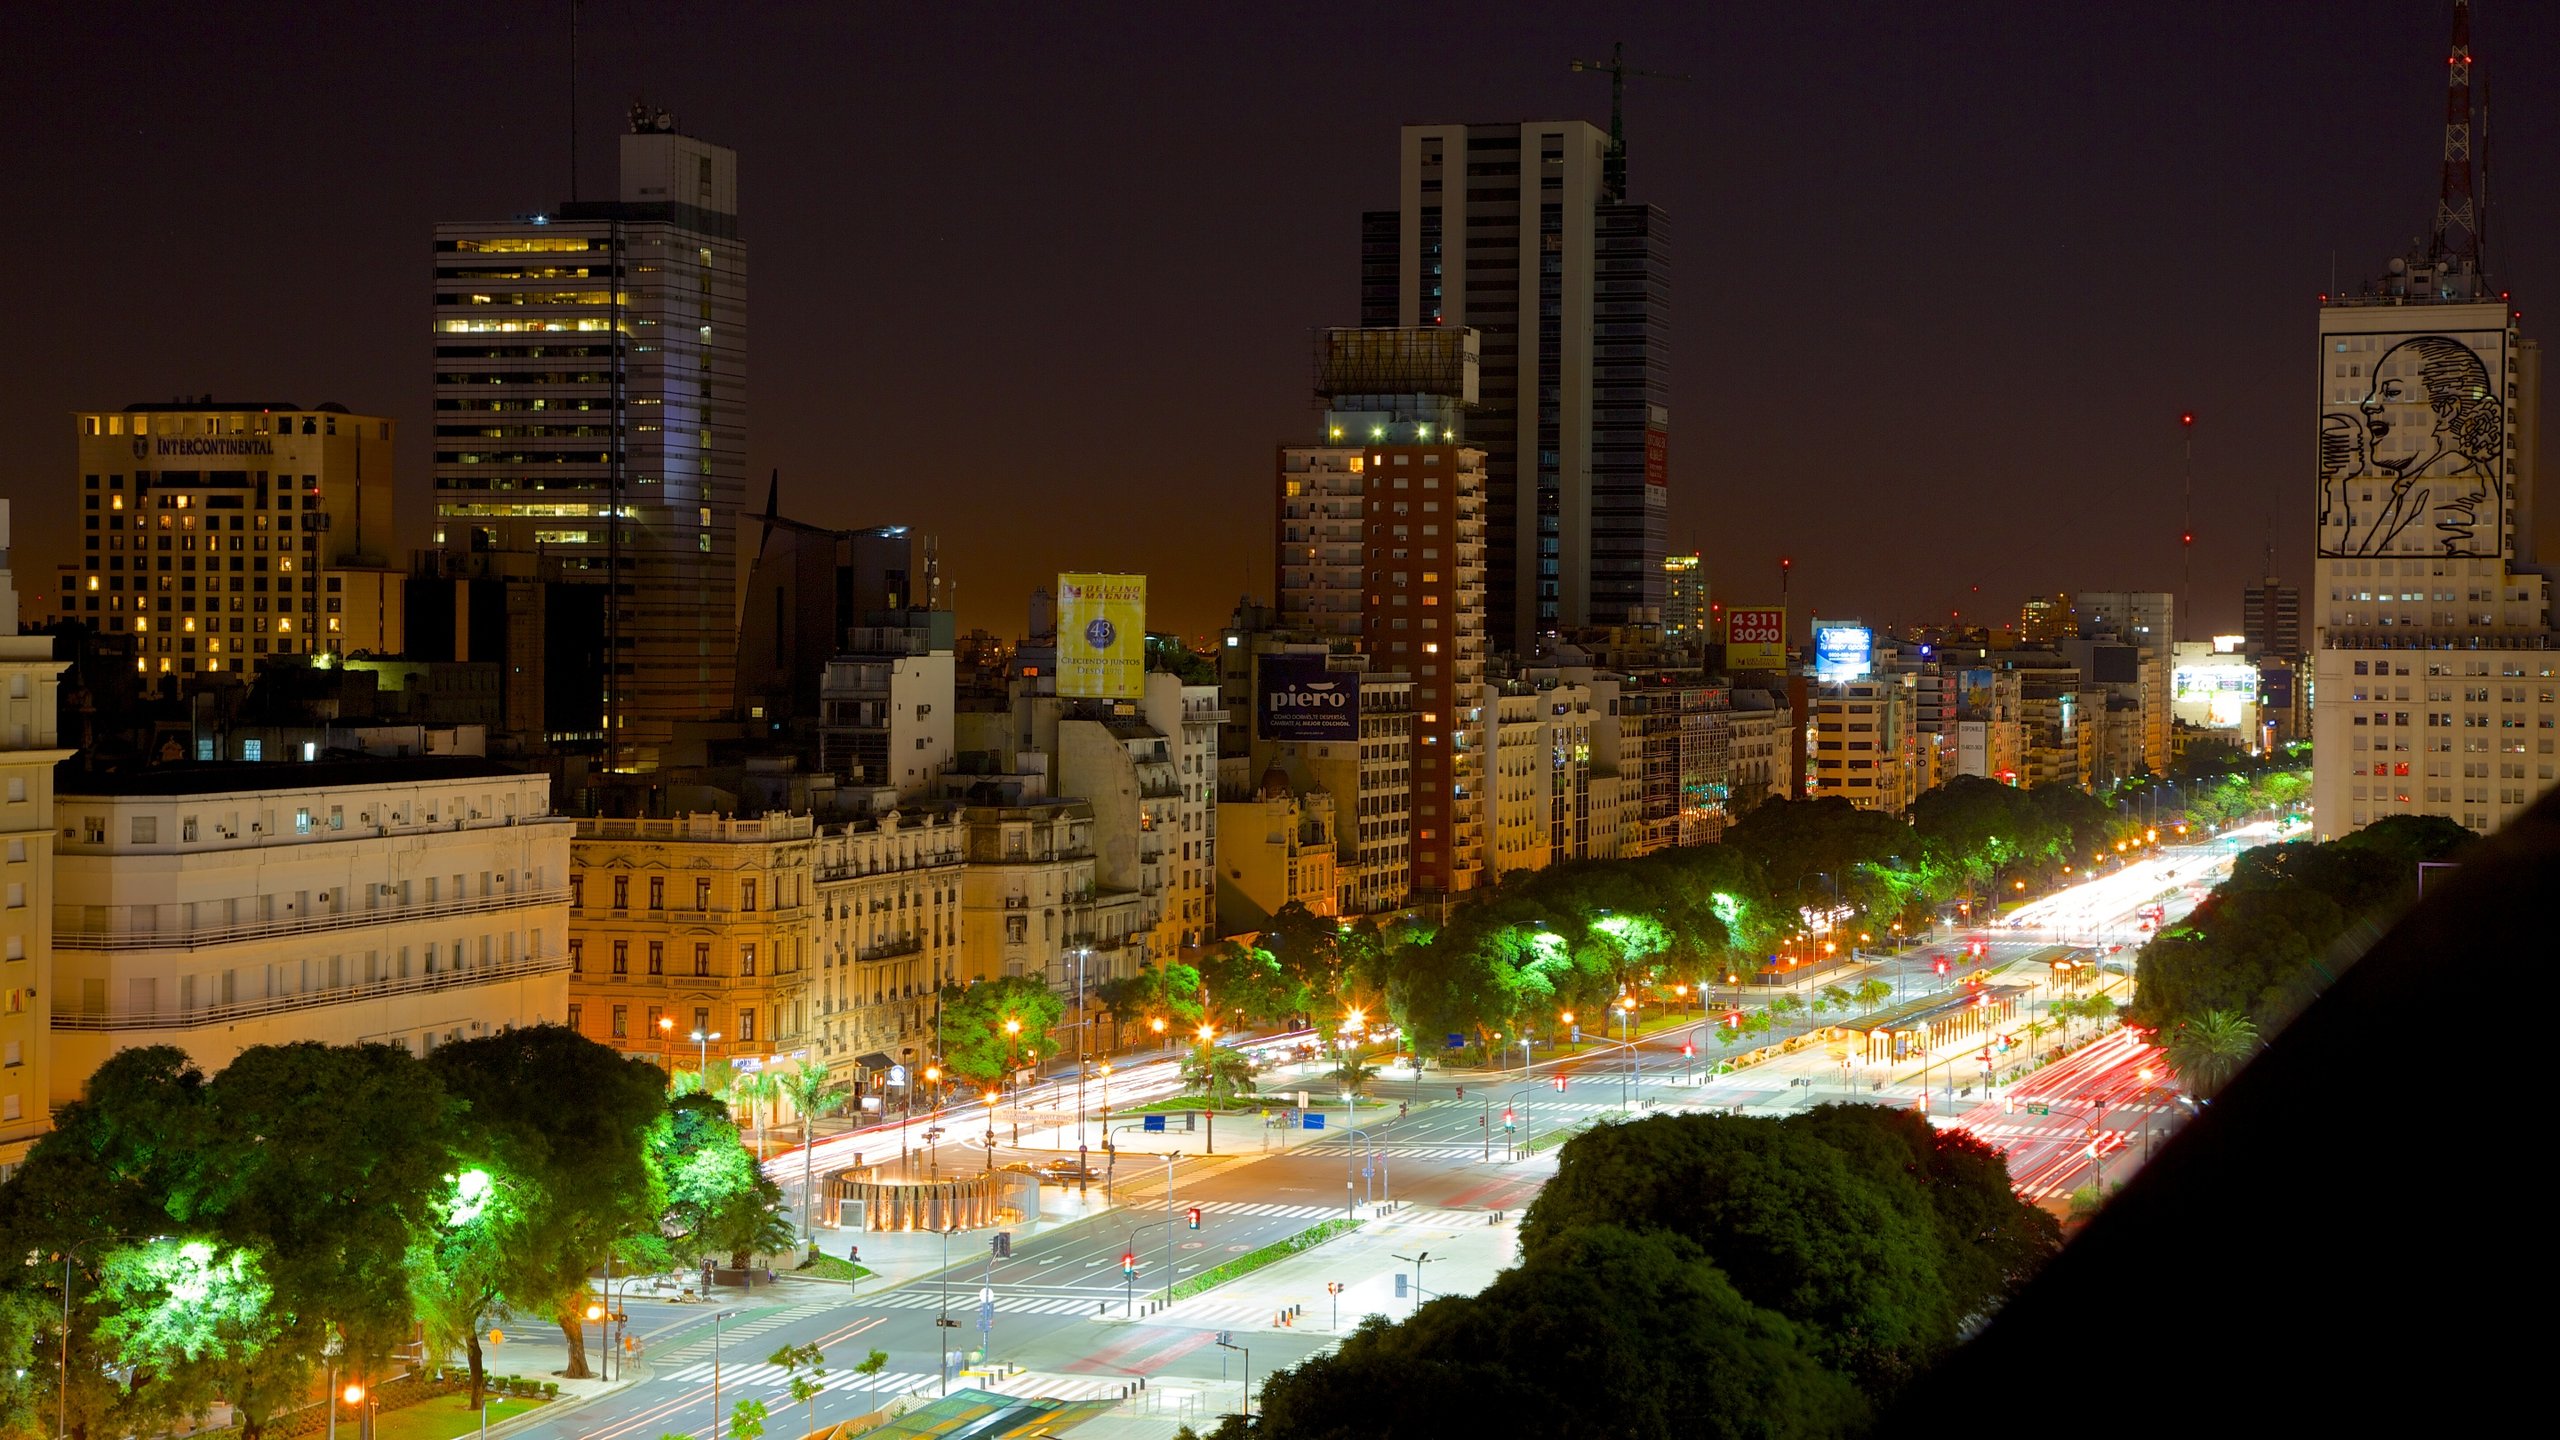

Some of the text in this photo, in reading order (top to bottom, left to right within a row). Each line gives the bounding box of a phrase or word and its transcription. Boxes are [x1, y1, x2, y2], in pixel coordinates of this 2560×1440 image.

[1086, 585, 1140, 593] DELFINO
[1085, 592, 1139, 600] MAGNUS
[1089, 621, 1110, 637] 43
[1733, 628, 1780, 641] 3020
[1061, 656, 1140, 666] CRECIENDO JUNTOS
[1077, 666, 1104, 675] DESDE
[1270, 684, 1346, 712] piero
